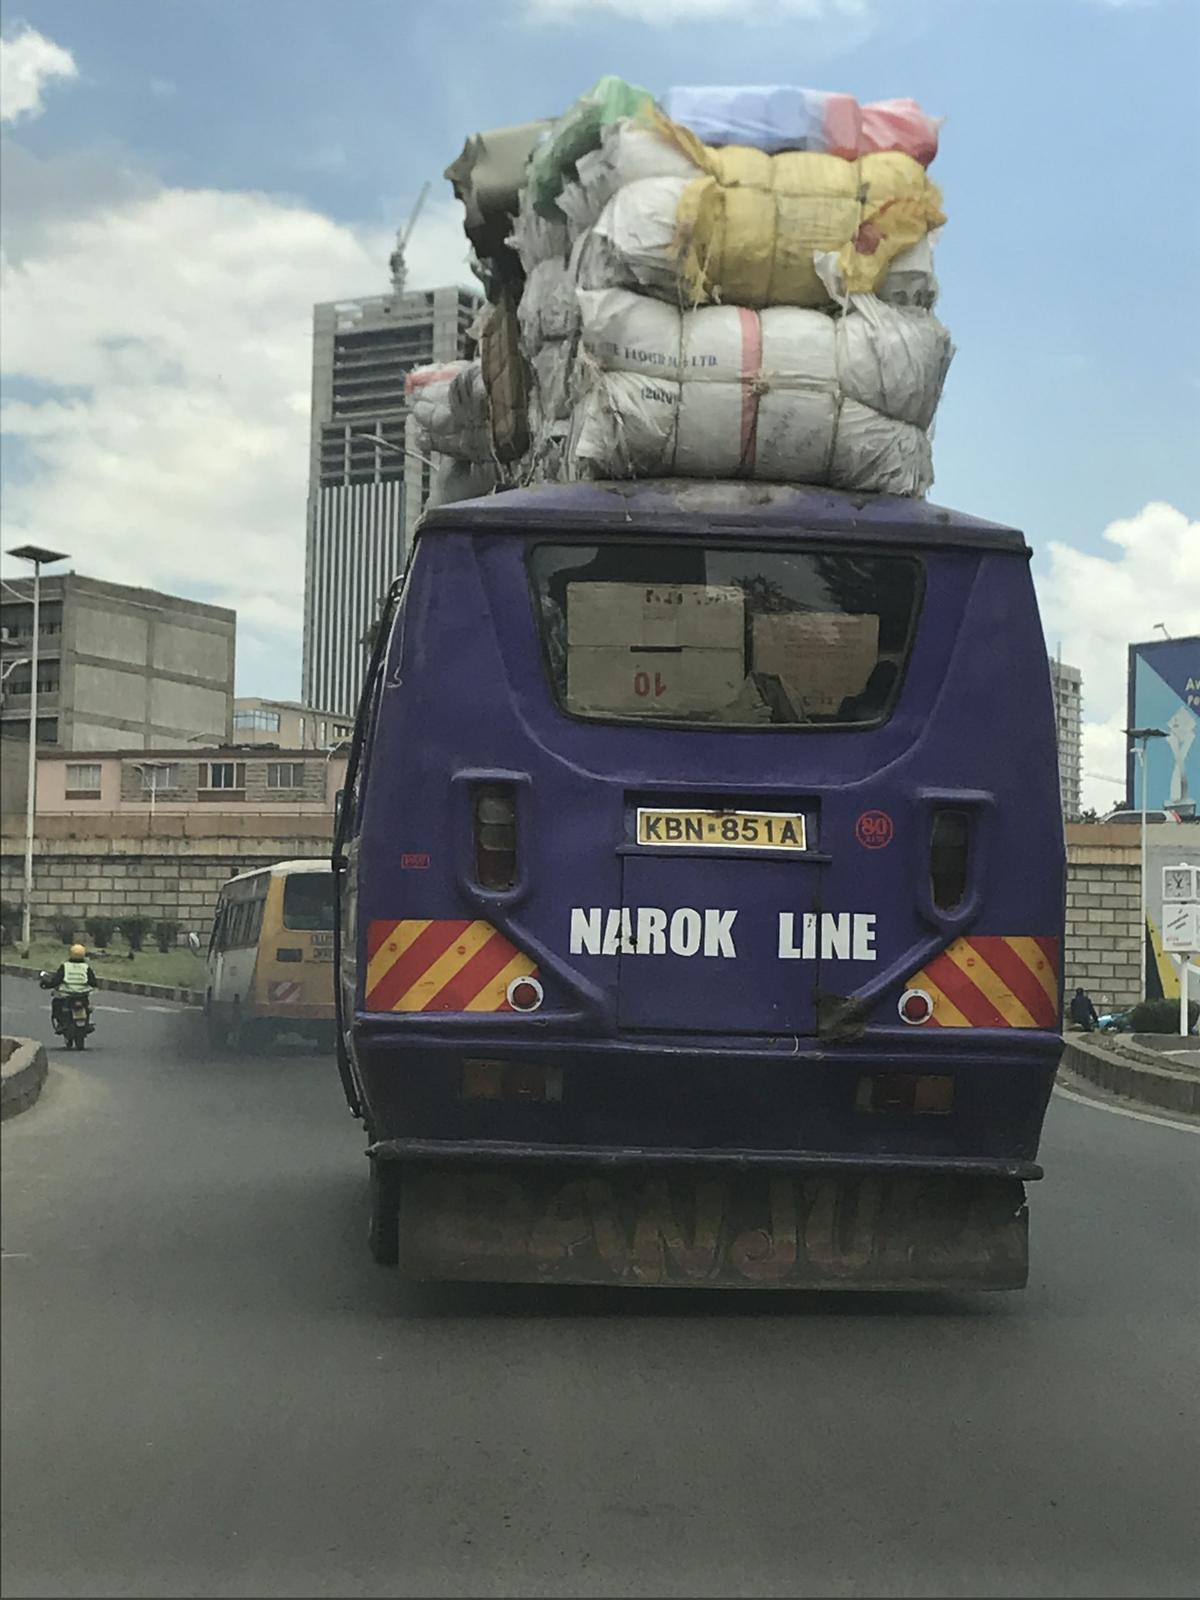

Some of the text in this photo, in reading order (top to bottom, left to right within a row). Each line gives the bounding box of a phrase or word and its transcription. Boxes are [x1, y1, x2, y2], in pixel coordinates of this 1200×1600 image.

[644, 816, 800, 845] KBN 851A
[862, 818, 888, 835] 80
[569, 907, 877, 961] NAROK LINE
